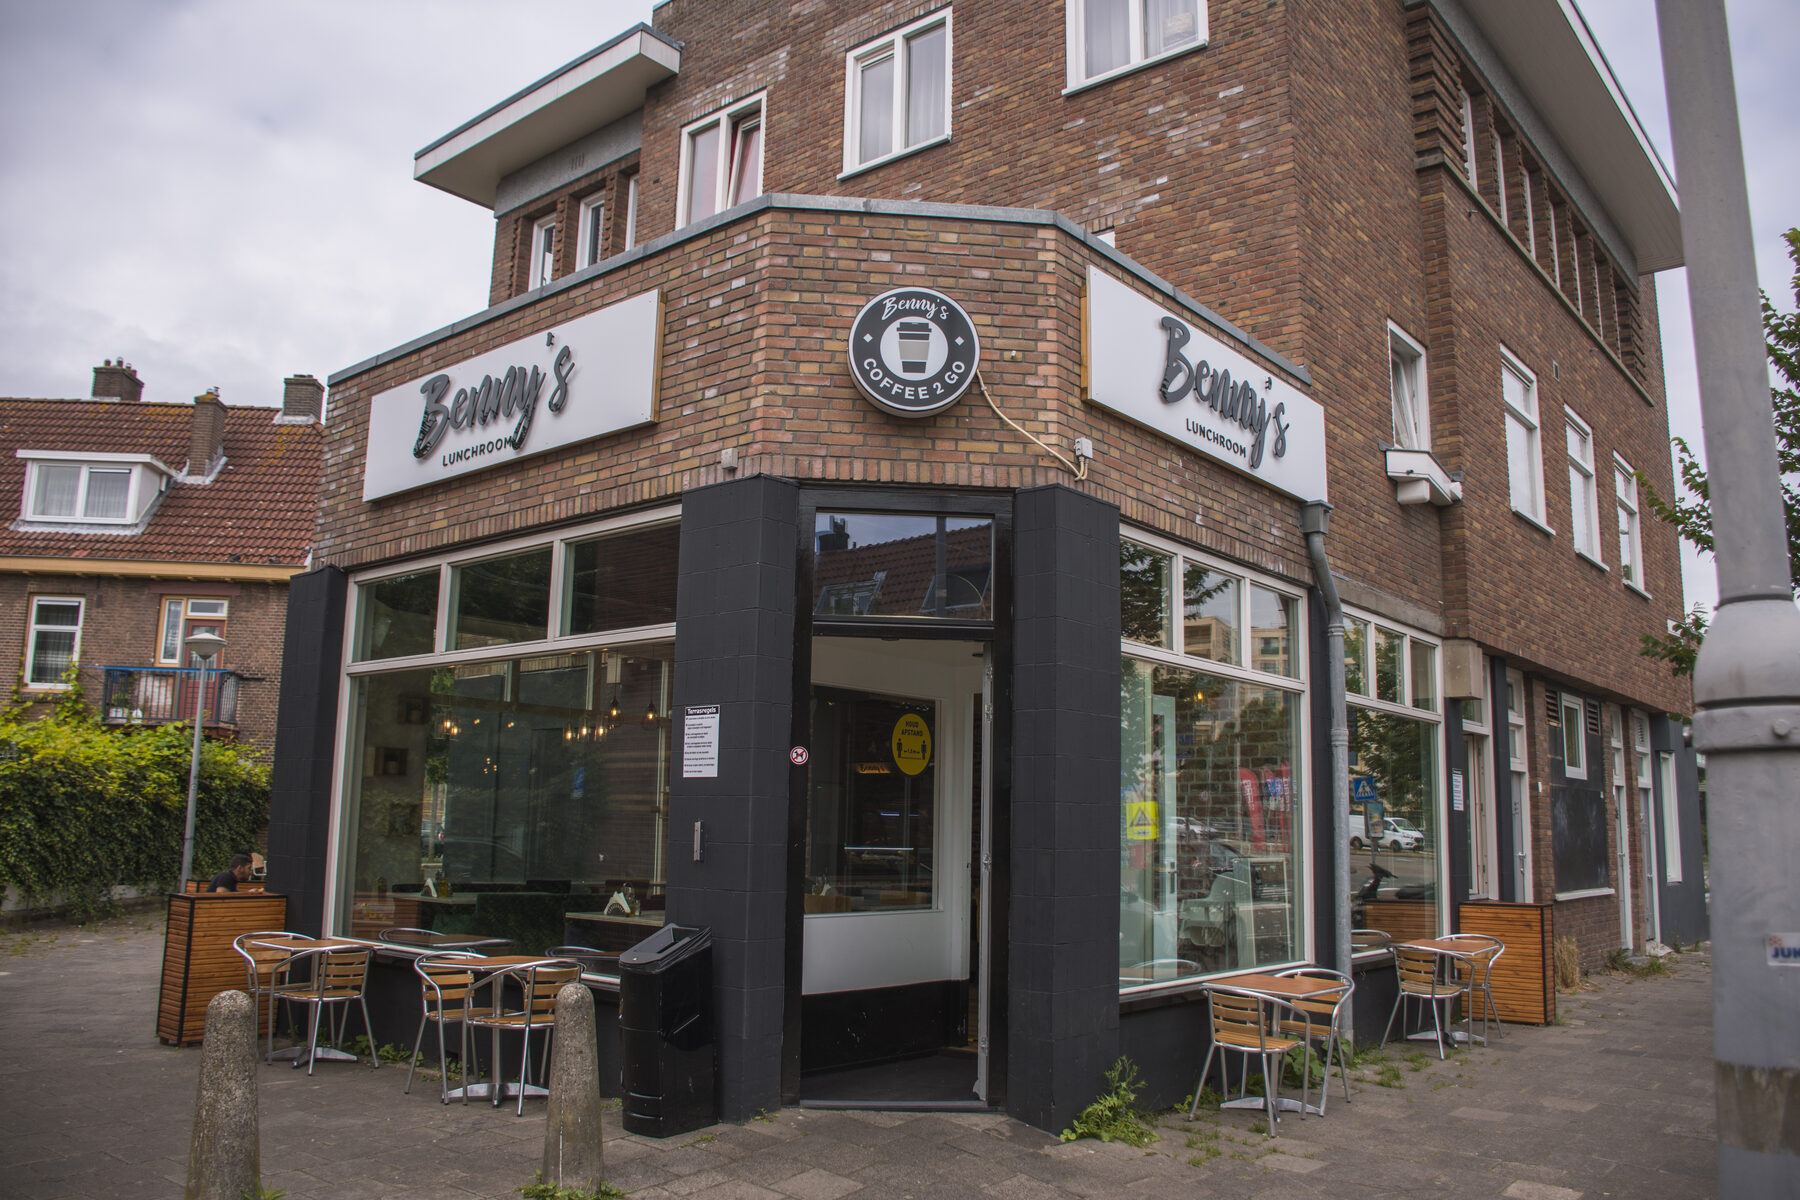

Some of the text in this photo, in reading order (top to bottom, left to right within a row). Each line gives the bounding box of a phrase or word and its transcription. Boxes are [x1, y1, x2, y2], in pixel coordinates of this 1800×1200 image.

[882, 297, 949, 321] Benny's
[413, 332, 575, 459] Benny's
[863, 358, 966, 400] COFFEE 2 GO
[1160, 316, 1290, 469] Benny's
[442, 436, 513, 467] LUNCHROOM
[1186, 418, 1247, 458] LUNCHROOM
